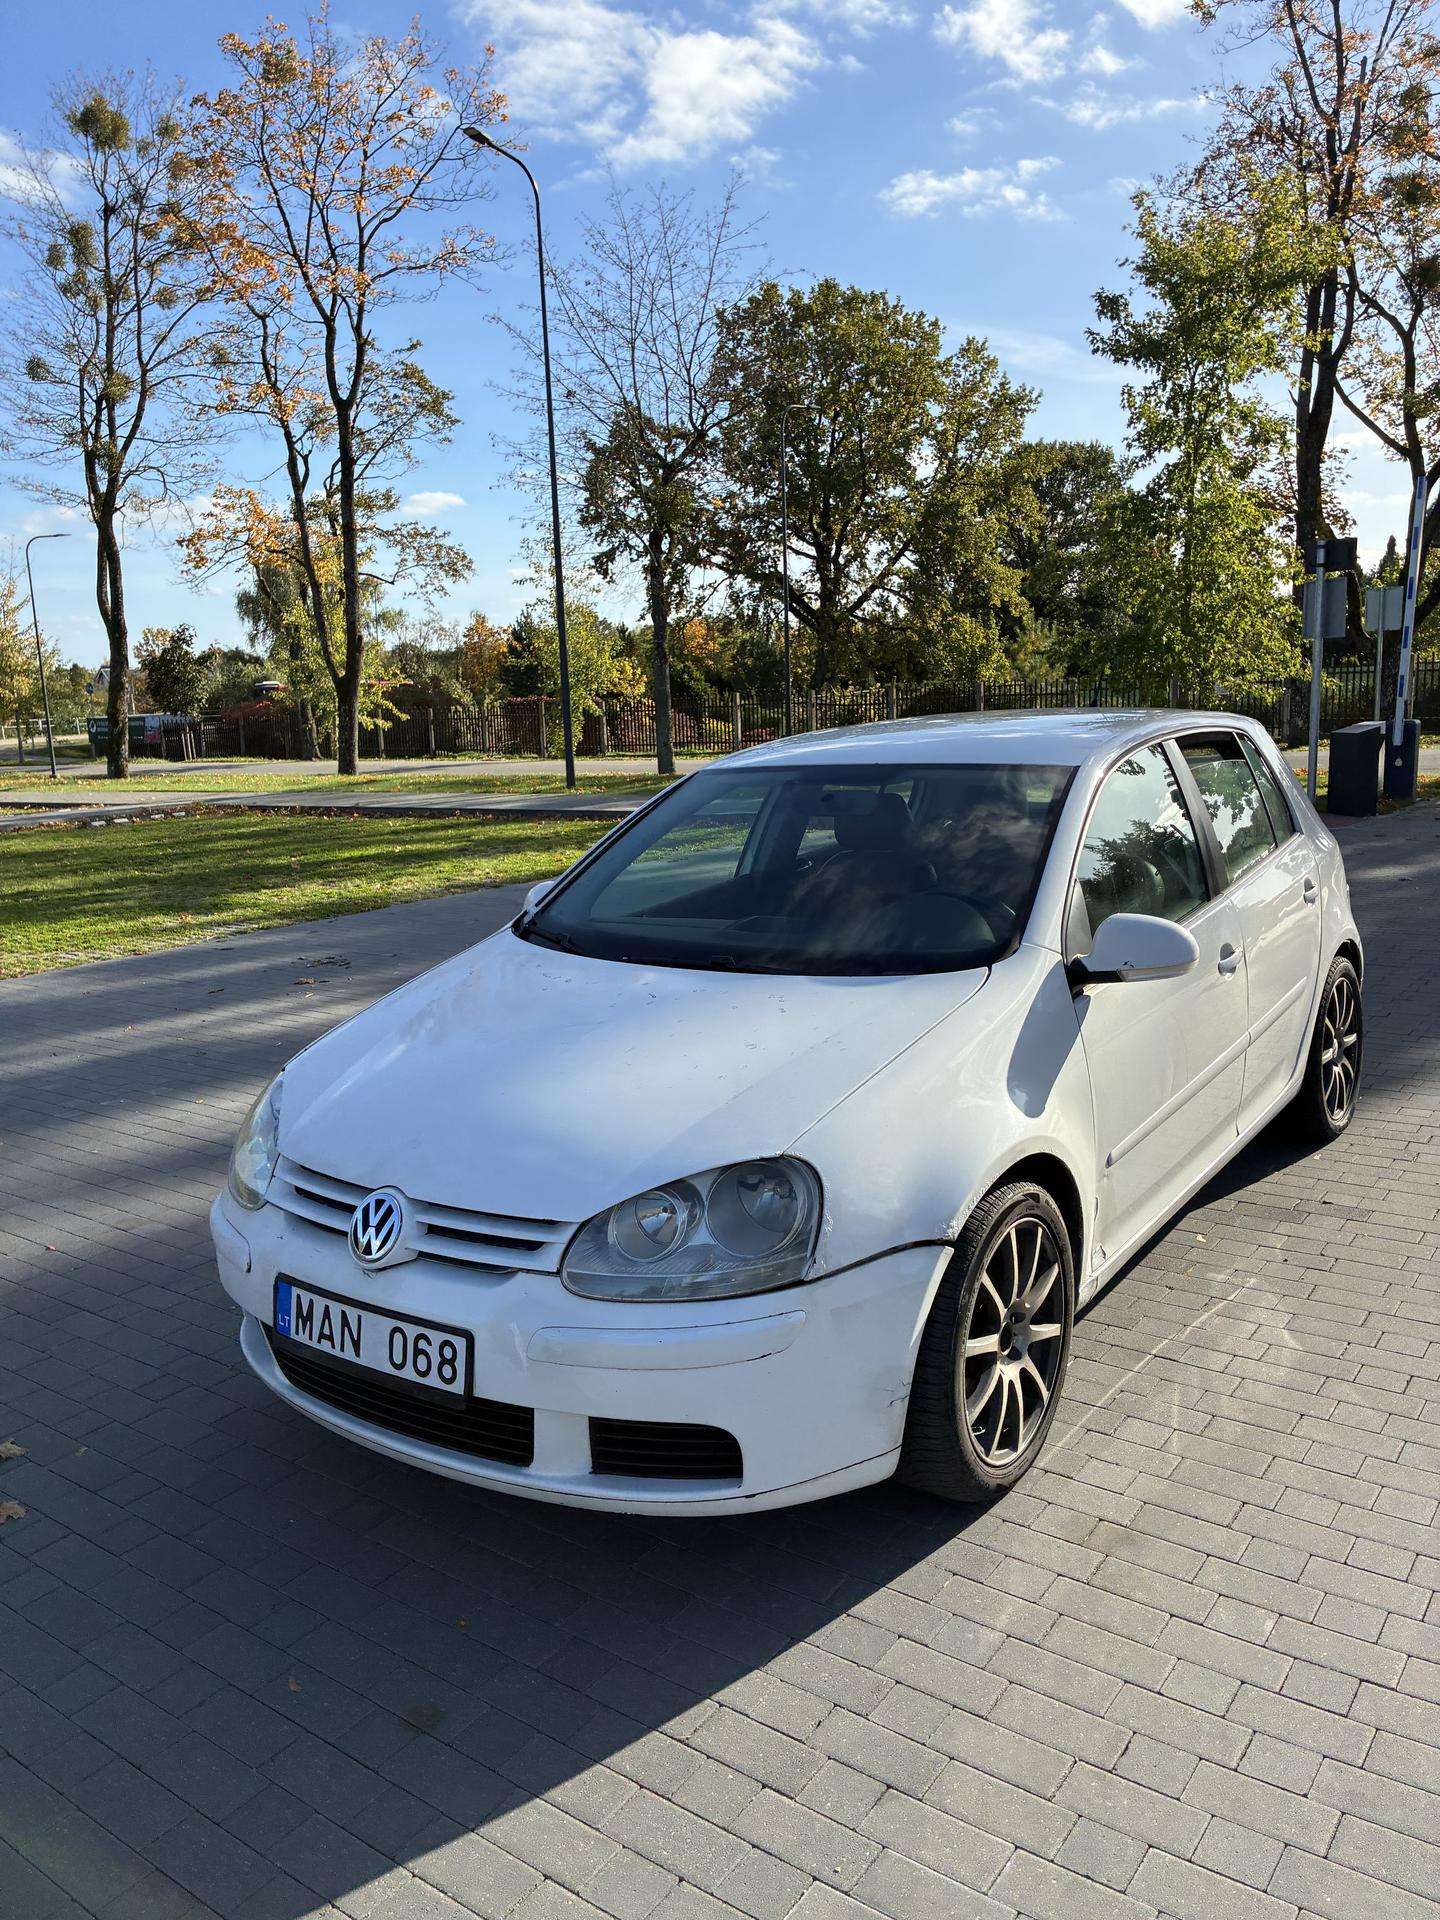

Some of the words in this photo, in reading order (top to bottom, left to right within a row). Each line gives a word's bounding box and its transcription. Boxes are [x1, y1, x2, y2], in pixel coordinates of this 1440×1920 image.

[278, 1313, 290, 1327] LT
[295, 1293, 362, 1358] MAN
[389, 1326, 458, 1385] 068
